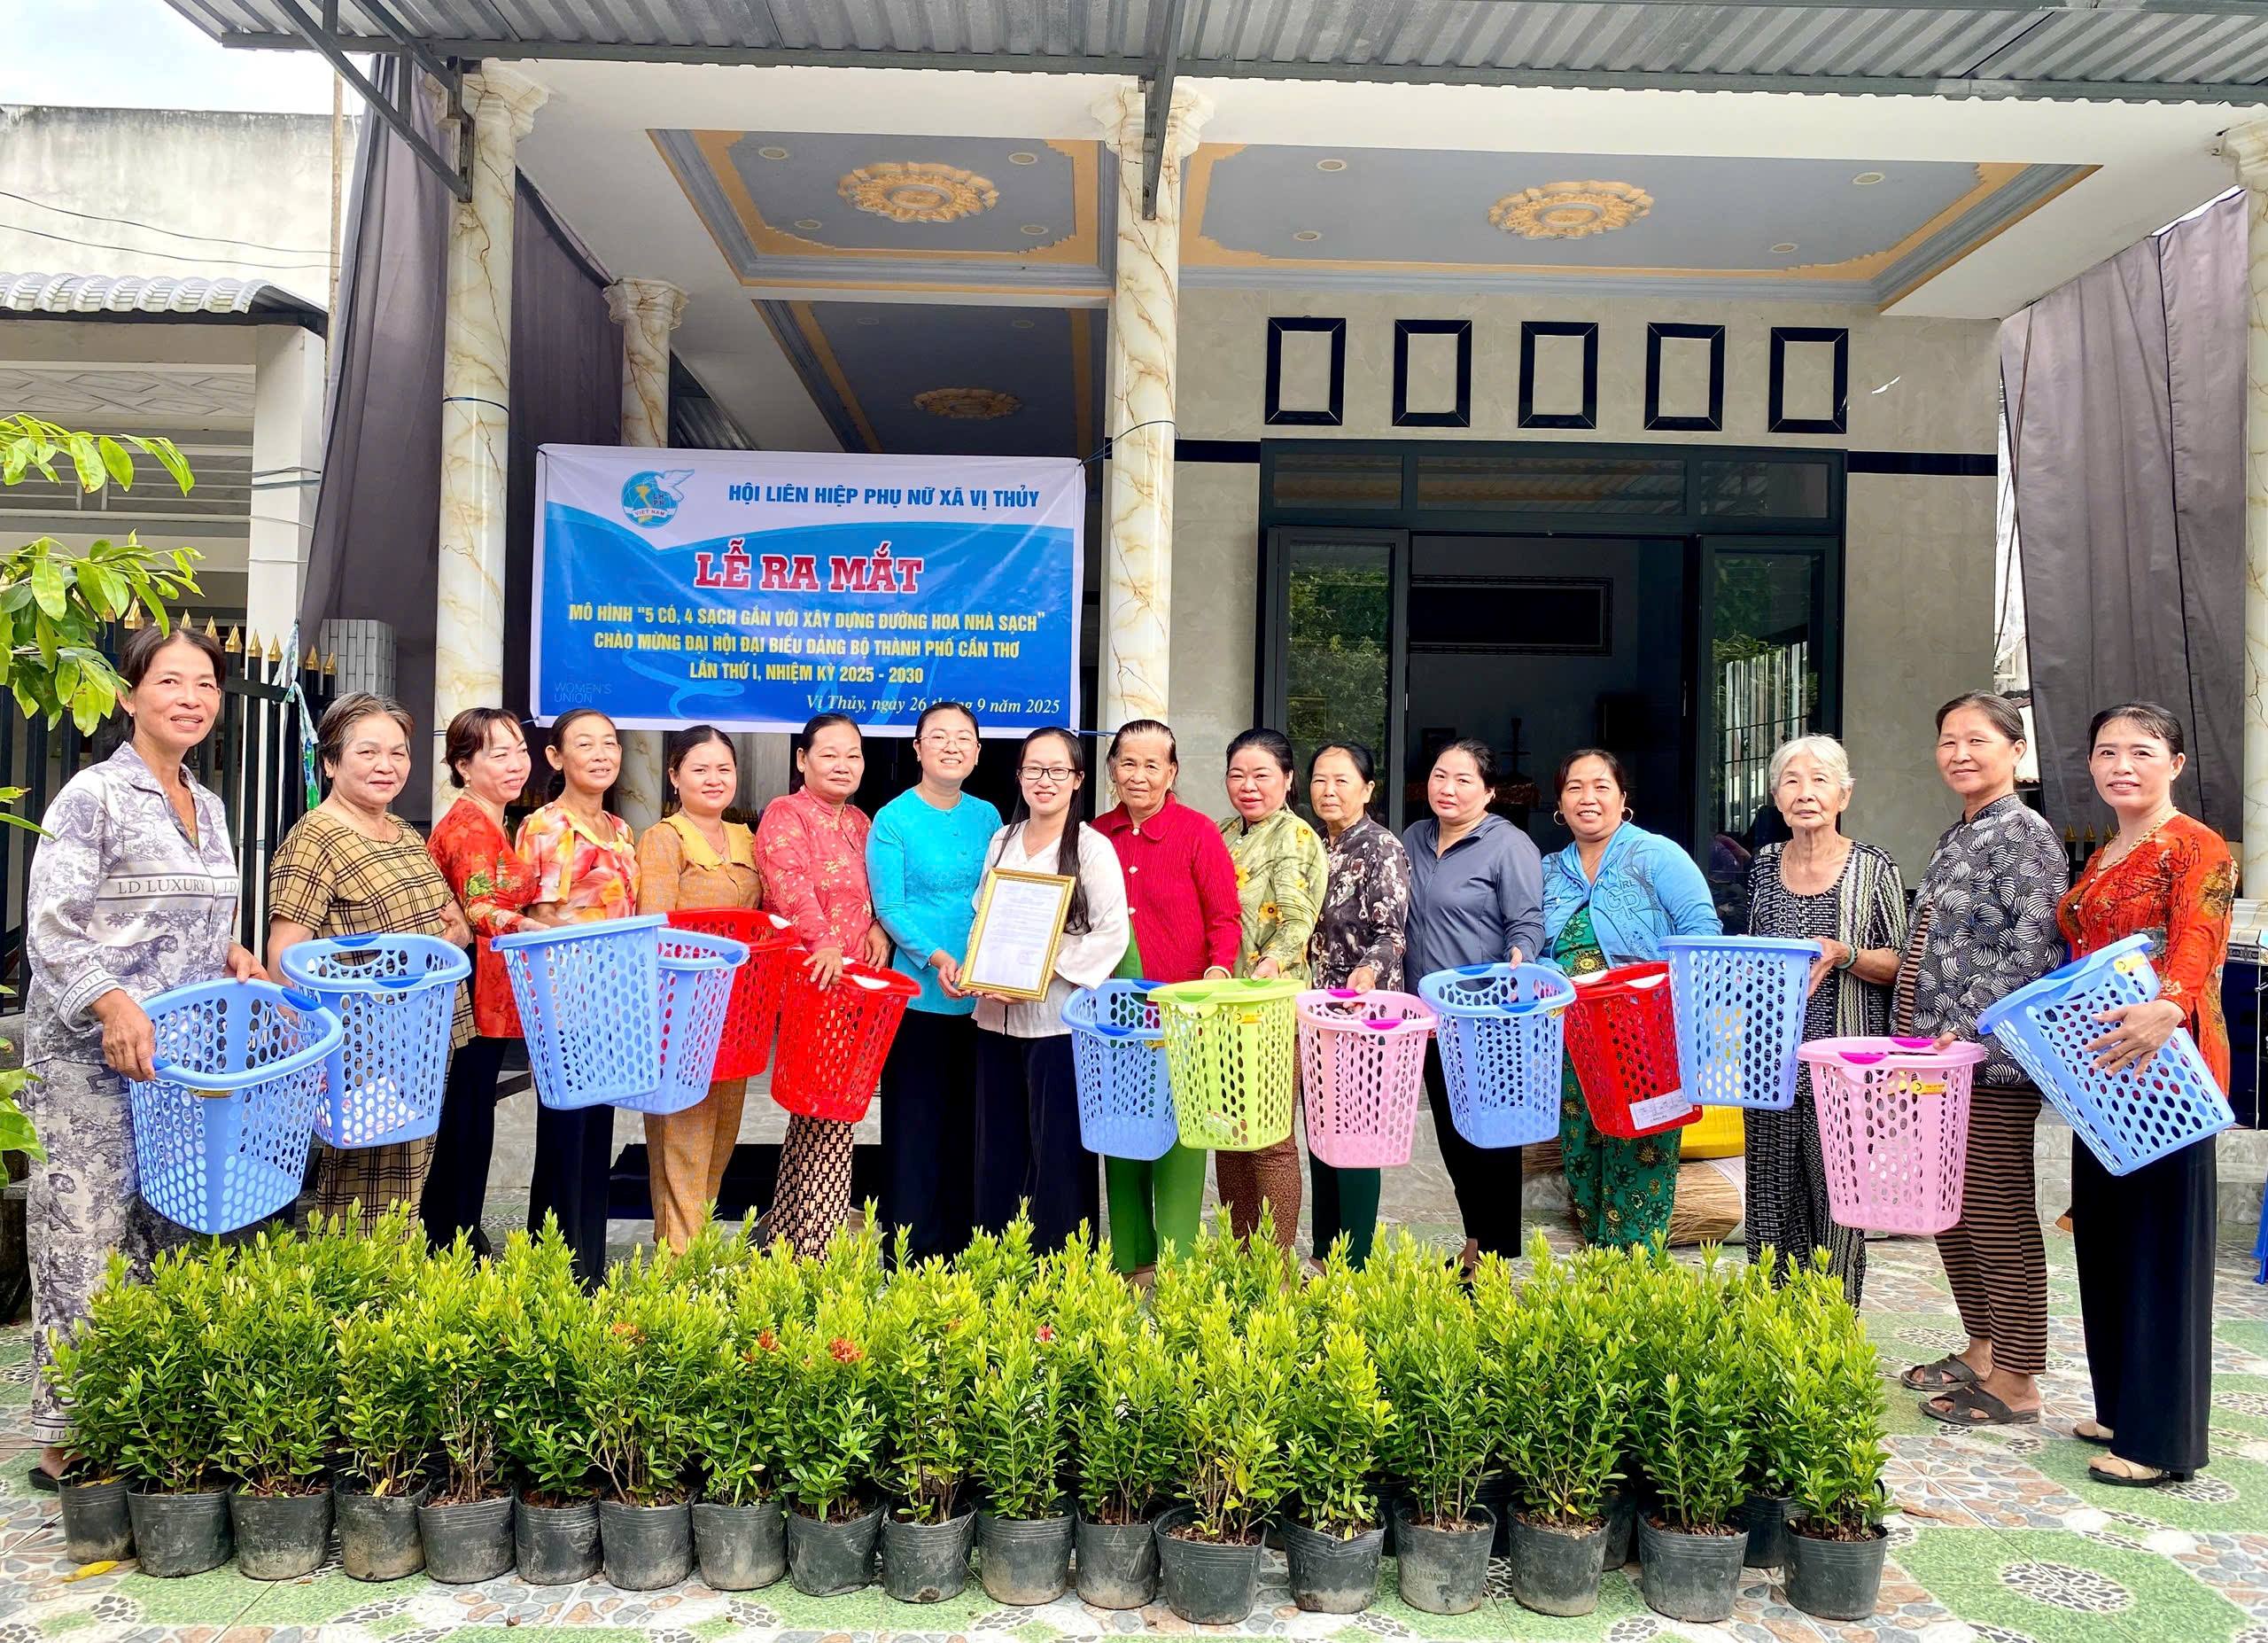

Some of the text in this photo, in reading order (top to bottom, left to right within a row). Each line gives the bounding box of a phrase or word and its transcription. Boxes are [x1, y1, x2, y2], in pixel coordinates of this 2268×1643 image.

[728, 483, 1040, 510] HỘI LIÊN HIỆP PHỤ NỮ XÃ VỊ THỦY
[695, 539, 923, 592] LỄ RA MẮT
[569, 602, 593, 620] MÔ
[597, 603, 633, 622] HÌNH
[658, 604, 680, 625] CÓ,
[684, 608, 693, 624] 4
[697, 608, 736, 628] SẠCH
[775, 608, 798, 627] VỚI
[803, 609, 831, 628] XÂY
[835, 610, 875, 633] DỰNG
[879, 609, 928, 630] ĐƯỜNG
[932, 614, 959, 630] HOA
[964, 611, 994, 631] NHÀ
[594, 630, 633, 649] CHÀO
[638, 630, 680, 650] MỪNG
[685, 635, 709, 654] ĐẠI
[712, 633, 736, 655] HỘI
[740, 635, 765, 656] ĐẠI
[769, 631, 803, 653] BIỂU
[805, 633, 846, 655] ĐẢNG
[850, 635, 870, 658] BỘ
[874, 636, 920, 658] THÀNH
[925, 635, 955, 657] PHỐ
[992, 641, 1020, 658] THƠ
[722, 659, 750, 680] THỨ
[752, 663, 761, 681] I,
[765, 661, 812, 684] NHIỆM
[817, 662, 836, 681] KỲ
[839, 666, 874, 683] 2025
[888, 666, 924, 684] 2030
[553, 692, 593, 704] UNION
[806, 694, 823, 712] Vị
[828, 694, 866, 712] Thủy,
[871, 697, 905, 714] ngày
[909, 696, 927, 712] 26
[977, 697, 986, 712] 9
[990, 698, 1021, 713] năm
[1025, 698, 1060, 714] 2025
[118, 878, 206, 894] LD LUXURY
[223, 881, 237, 893] LD
